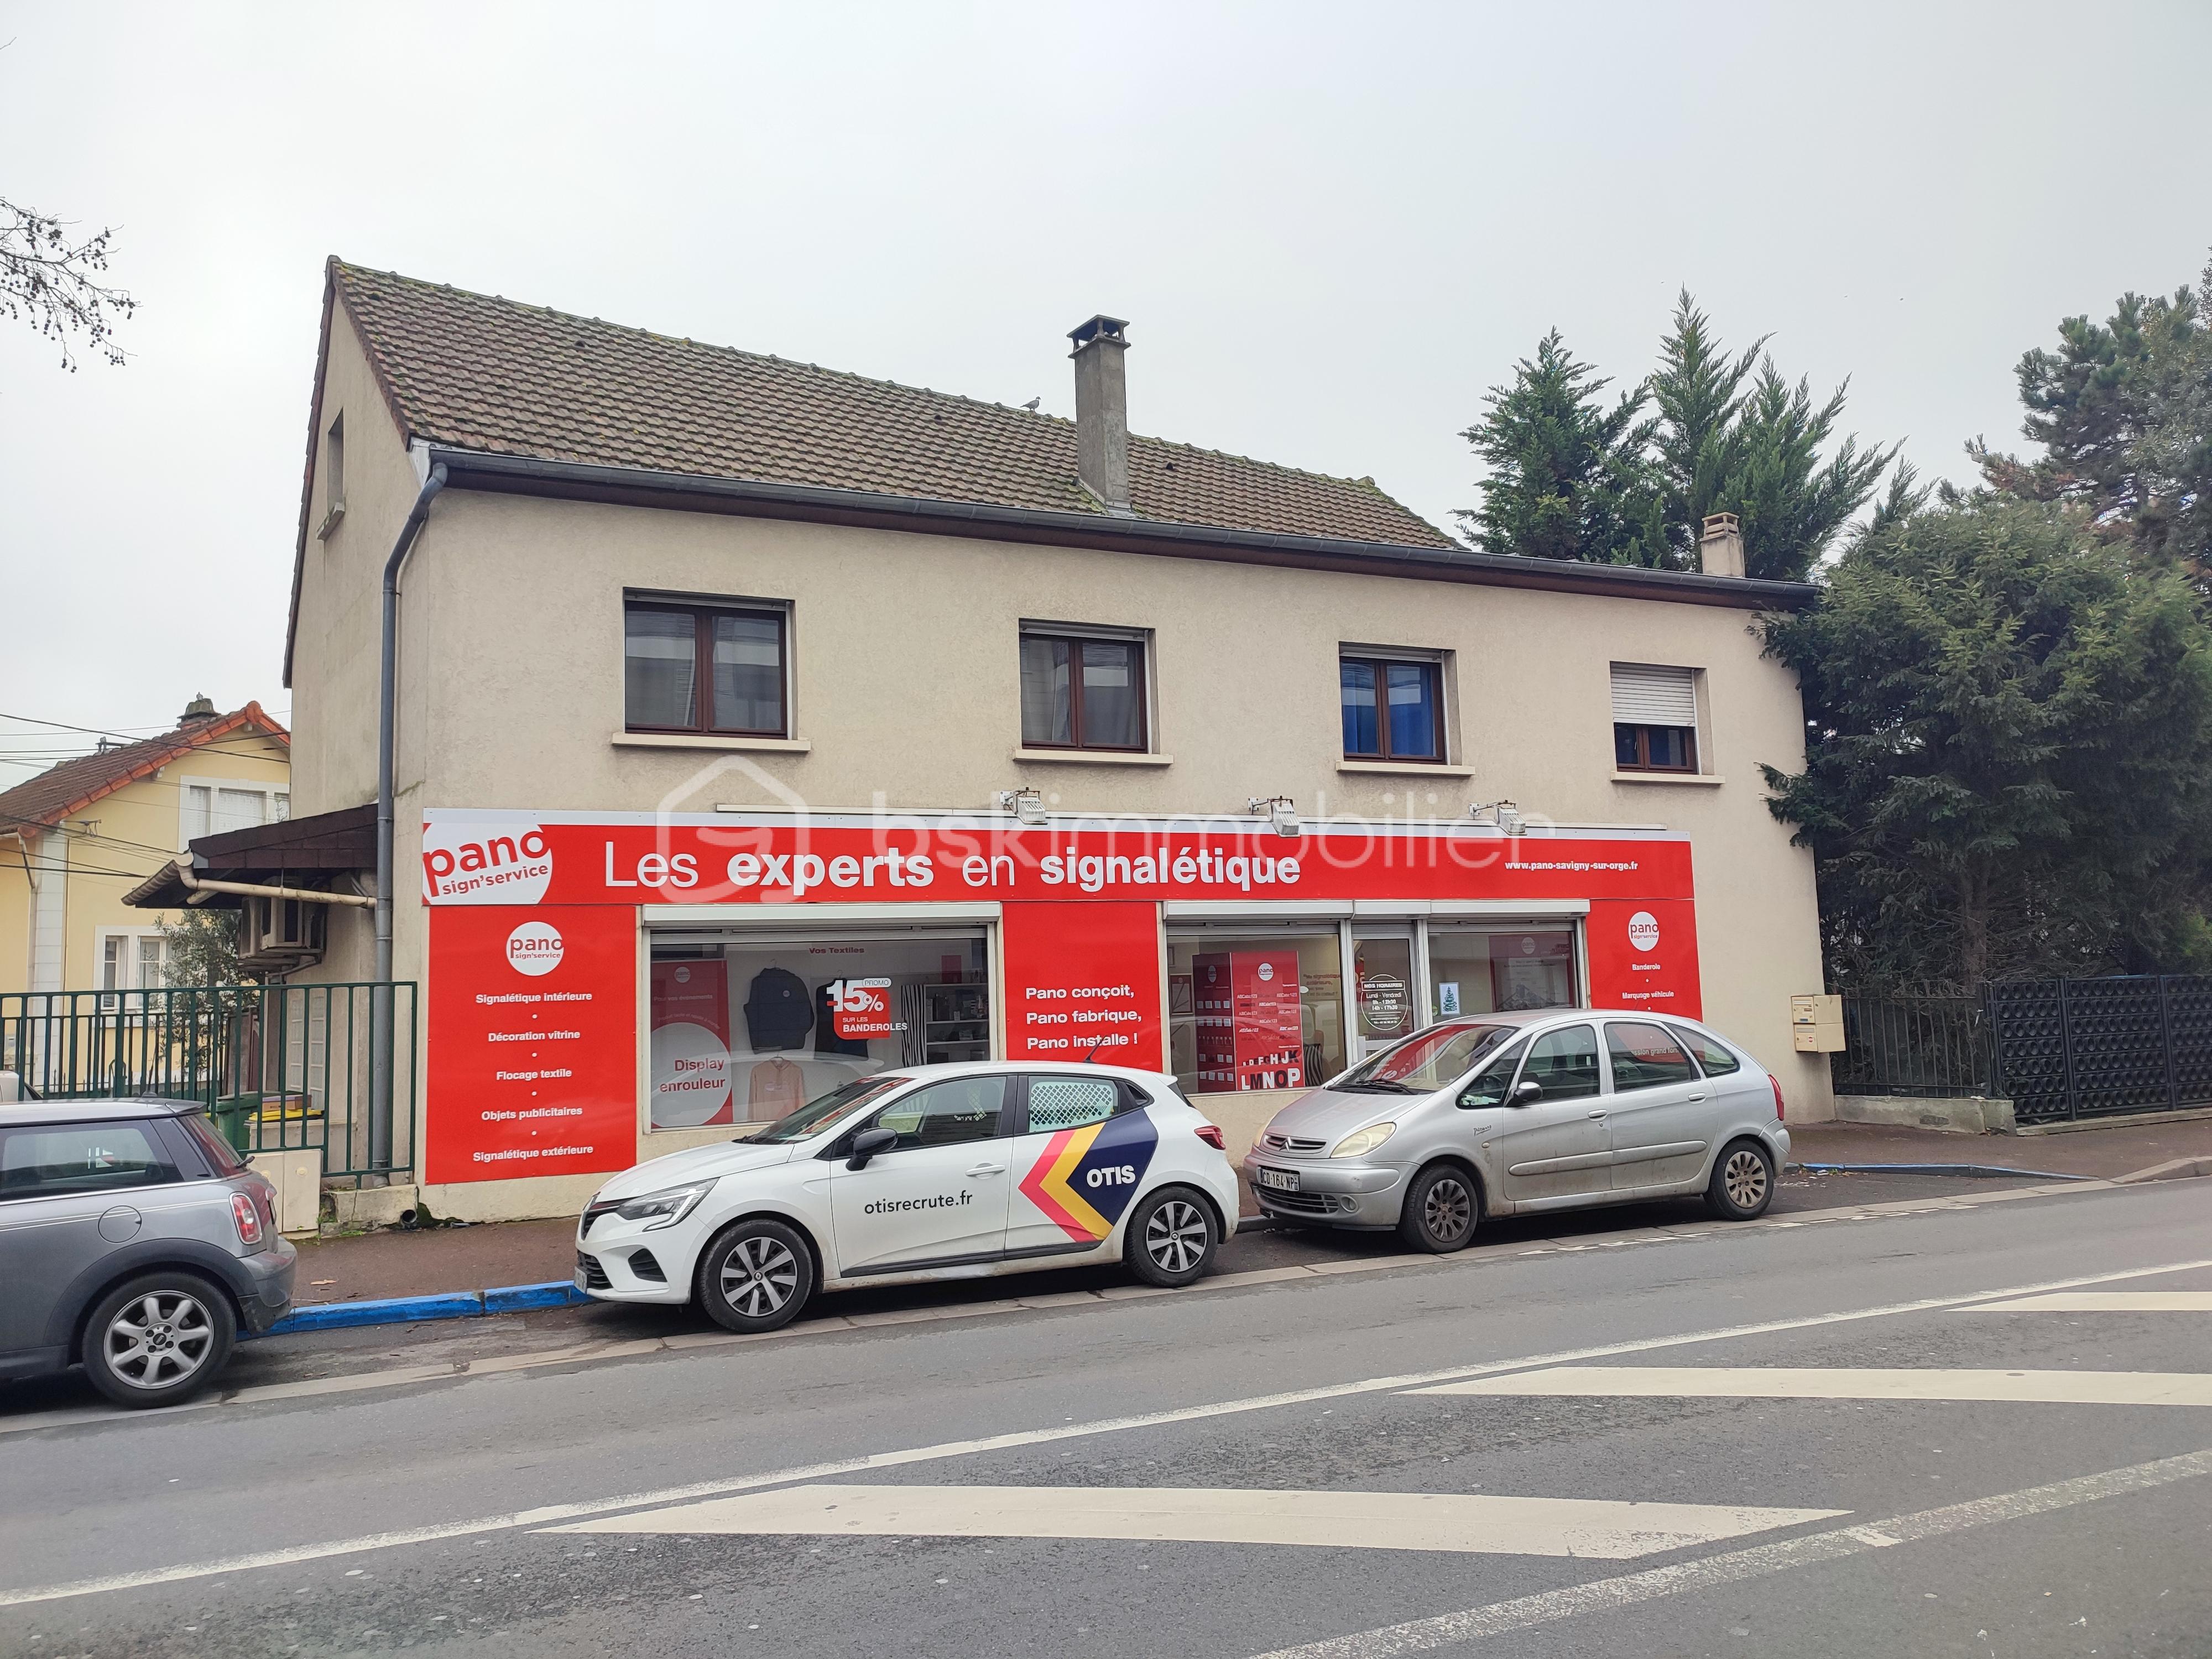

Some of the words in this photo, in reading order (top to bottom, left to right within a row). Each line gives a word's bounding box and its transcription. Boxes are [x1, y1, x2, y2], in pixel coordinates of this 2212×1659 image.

[423, 831, 551, 897] pano
[606, 842, 698, 887] Les
[727, 847, 933, 896] experts
[962, 855, 1015, 886] en
[1040, 847, 1300, 892] signalétique
[1505, 860, 1638, 870] www.pano-savigny-sur-orge.fr
[442, 863, 548, 895] sign'service
[1630, 924, 1658, 938] pano
[510, 938, 564, 958] pano
[476, 993, 541, 1004] Signalétique
[544, 992, 592, 1002] intérieure
[1026, 988, 1067, 999] Pano
[1072, 985, 1134, 999] conçoit,
[1026, 1013, 1068, 1025] Pano
[1072, 1010, 1141, 1024] fabrique,
[843, 1022, 907, 1032] BANDEROLES
[488, 1032, 545, 1042] Décoration
[547, 1030, 581, 1040] vitrine
[1027, 1037, 1068, 1050] Pano
[1073, 1034, 1129, 1047] installe
[1651, 1047, 1666, 1056] grand
[675, 1058, 724, 1072] Display
[496, 1071, 538, 1081] Flocage
[540, 1068, 572, 1078] textile
[660, 1078, 726, 1092] enrouleur
[481, 1110, 516, 1121] Objets
[519, 1107, 583, 1119] publicitaires
[473, 1150, 539, 1162] Signalétique
[541, 1145, 593, 1156] extérieure
[1086, 1165, 1135, 1188] OTIS
[864, 1190, 973, 1214] otisrecrute.fr
